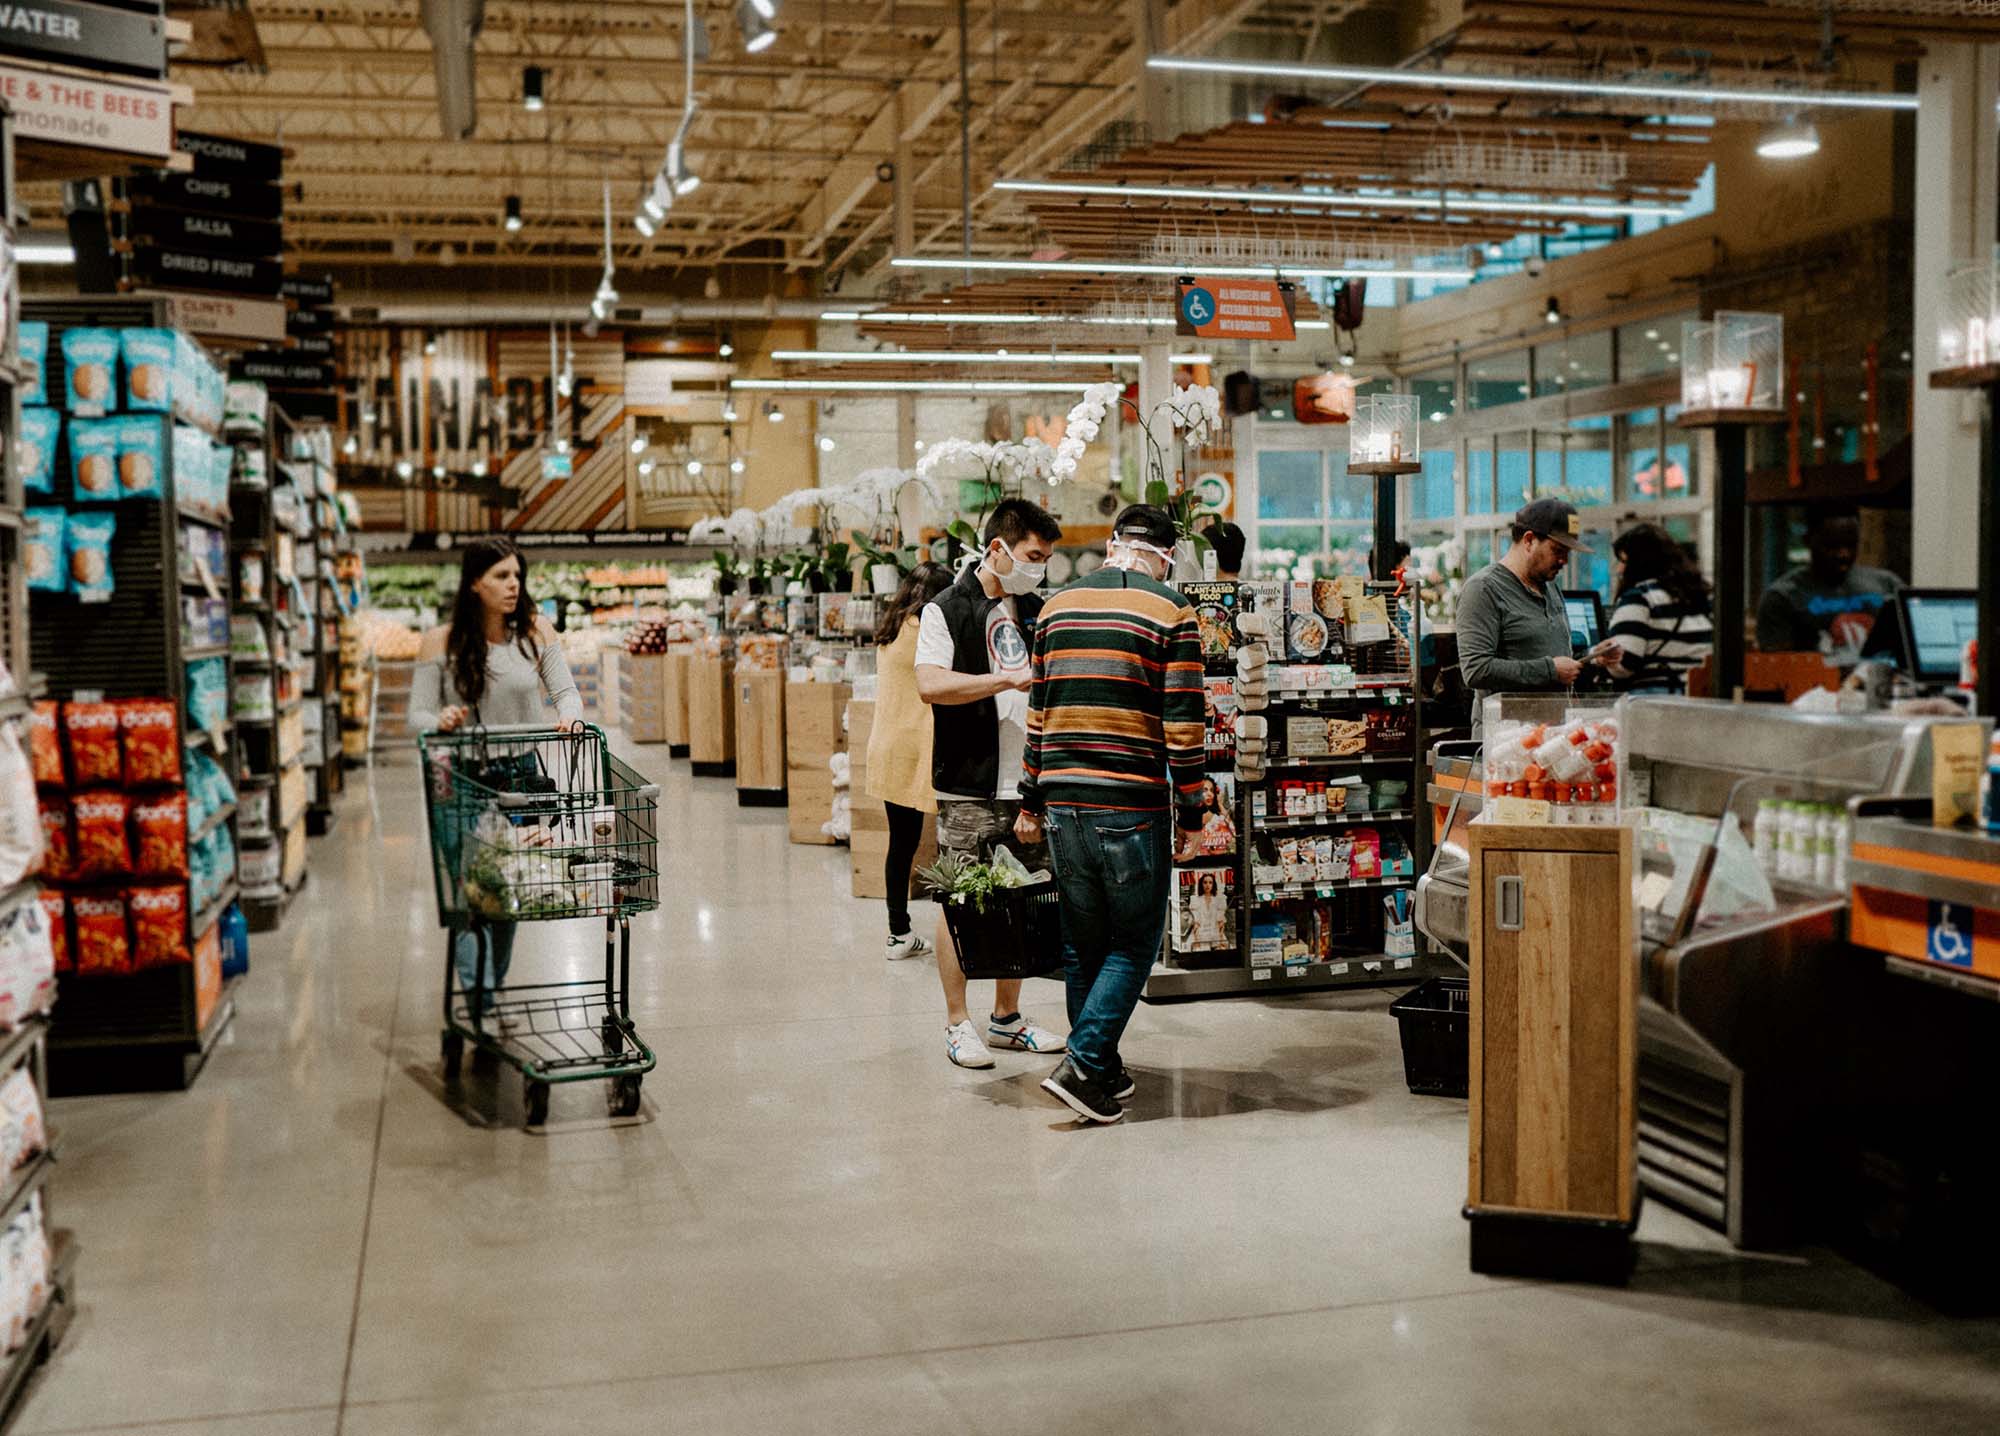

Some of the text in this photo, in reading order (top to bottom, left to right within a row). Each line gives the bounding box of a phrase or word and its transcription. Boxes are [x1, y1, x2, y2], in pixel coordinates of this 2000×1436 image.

[0, 77, 159, 120] E & THE BEES
[177, 138, 247, 161] OPCORN
[184, 178, 232, 199] CHIPS
[184, 216, 233, 237] SALSA
[160, 253, 255, 279] DRIED FRUIT
[1740, 361, 1758, 408] 7
[1184, 585, 1236, 595] PLANT-BASED
[1199, 593, 1222, 602] FOOD
[66, 711, 118, 731] dang
[121, 711, 173, 730] dang
[75, 802, 125, 822] dang
[134, 804, 182, 825] dang
[74, 898, 124, 919] dang
[130, 892, 181, 912] dang
